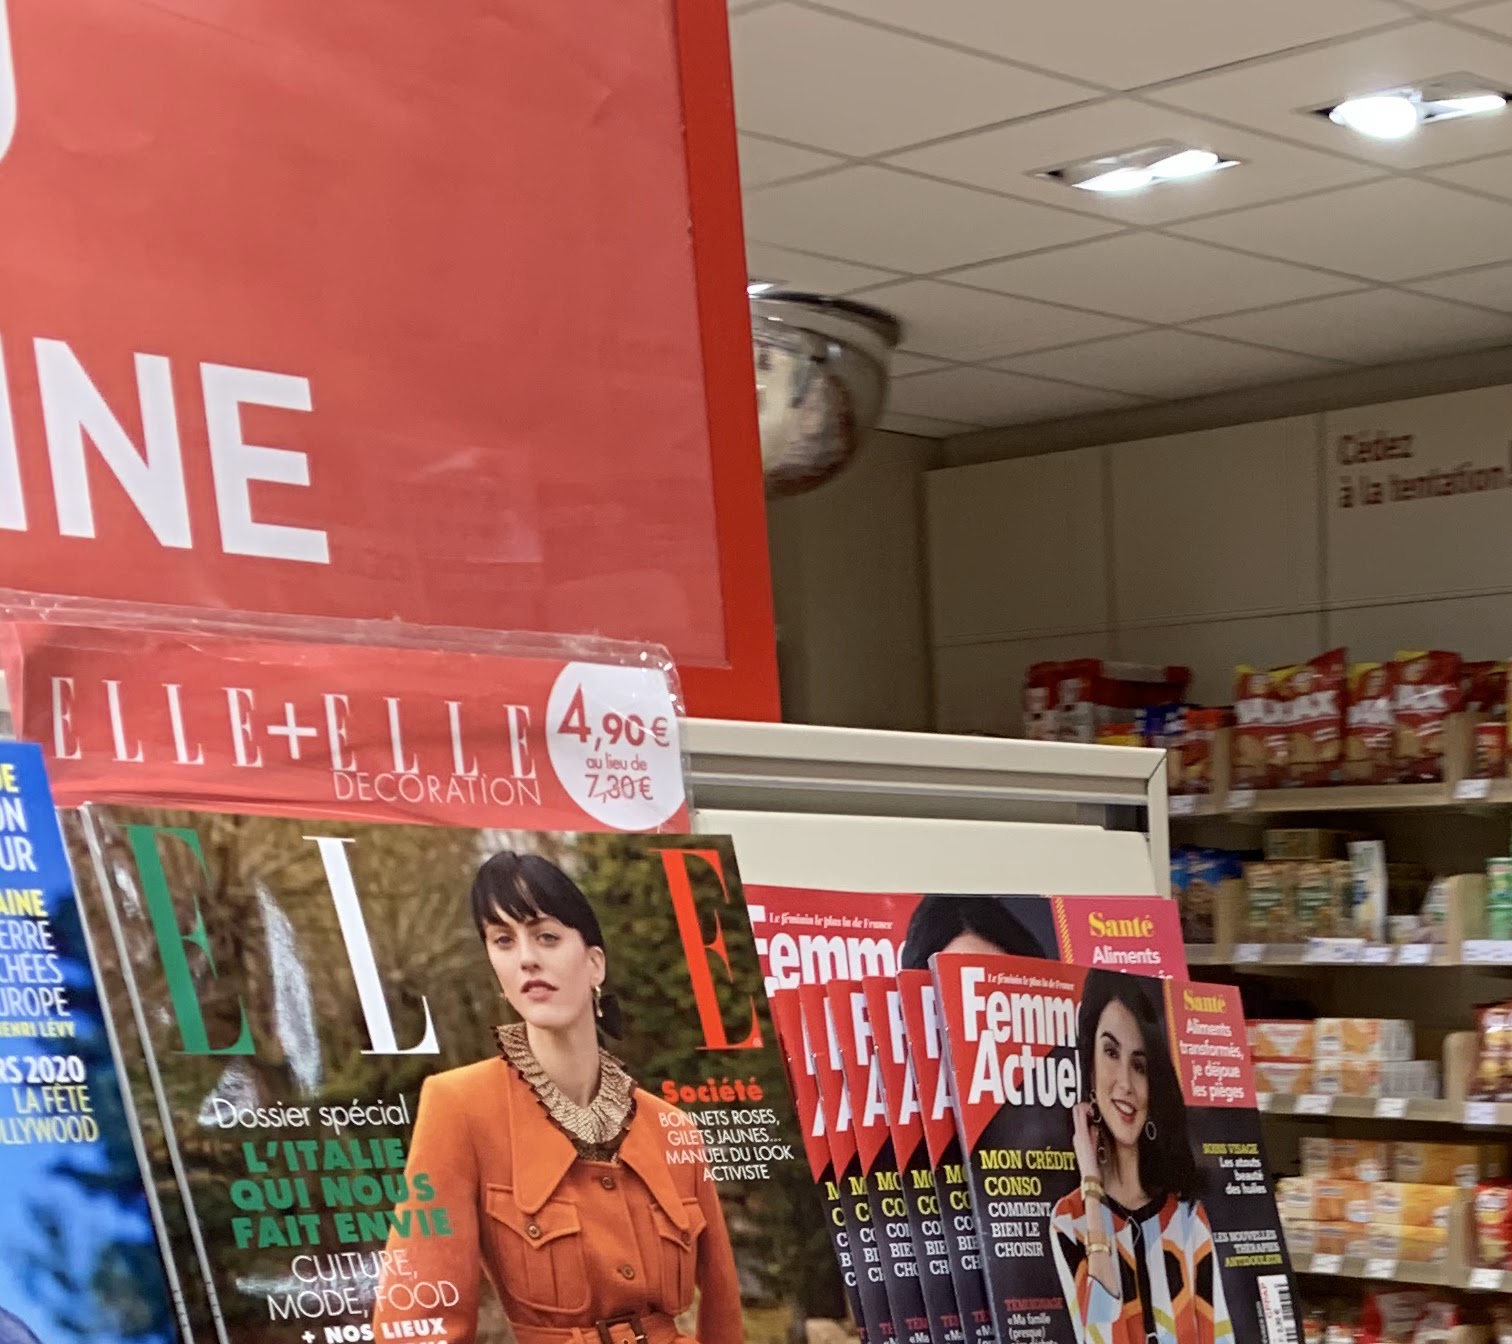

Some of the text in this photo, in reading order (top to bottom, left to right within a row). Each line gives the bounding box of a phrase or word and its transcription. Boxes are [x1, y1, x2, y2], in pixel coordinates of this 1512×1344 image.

[586, 754, 648, 772] au lieu de
[1087, 911, 1155, 939] Santé
[1092, 945, 1162, 966] Aliments
[1182, 988, 1228, 1015] Santé
[26, 1054, 86, 1084] 2020
[13, 1079, 94, 1114] LA FÊTE
[660, 1077, 764, 1104] Société
[211, 1092, 411, 1136] Dossier spécial
[658, 1109, 782, 1129] BONNETS ROSES,
[667, 1128, 714, 1147] GILETS
[241, 1137, 407, 1174] L'ITALIE
[665, 1145, 795, 1166] MANUEL DU LOOK
[979, 1146, 1077, 1171] MON CRÉDIT
[702, 1164, 771, 1183] ACTIVISTE
[984, 1175, 1042, 1198] CONSO
[230, 1172, 436, 1213] QUI NOUS
[987, 1201, 1052, 1219] COMMENT
[230, 1207, 454, 1249] FAIT ENVIE
[990, 1221, 1041, 1239] BIEN LE
[994, 1240, 1044, 1258] CHOISIR
[290, 1248, 418, 1284] CULTURE,
[266, 1280, 460, 1321] MODE, FOOD
[323, 1322, 375, 1344] NOS
[380, 1316, 448, 1340] LIEUX
